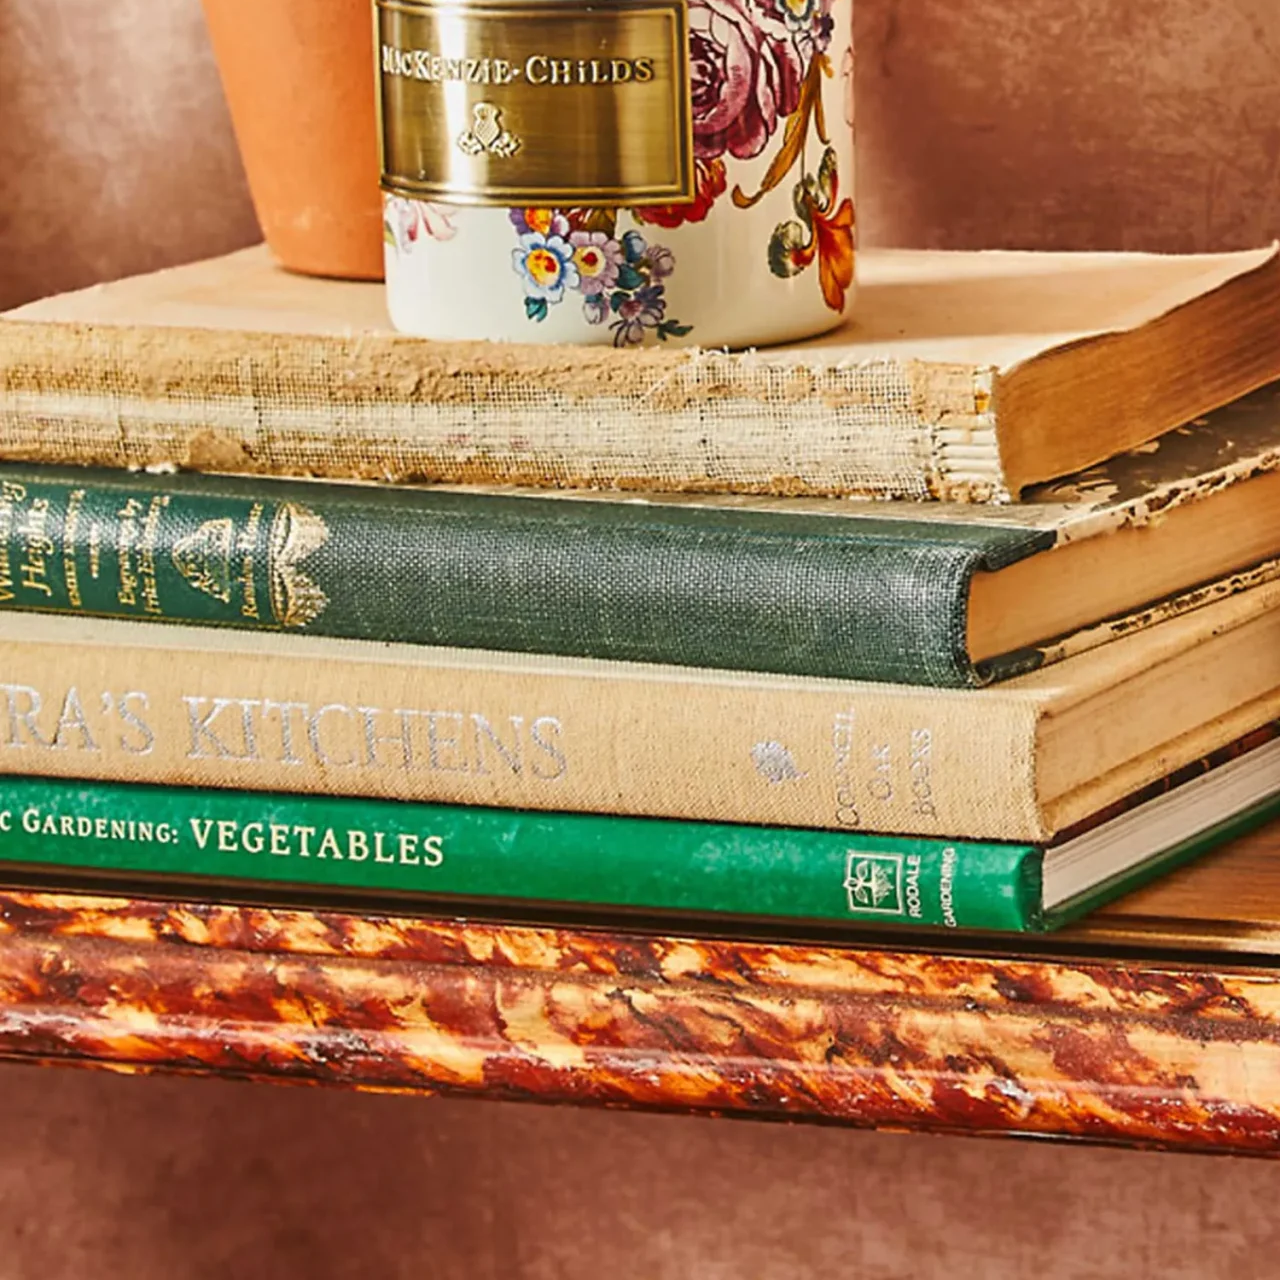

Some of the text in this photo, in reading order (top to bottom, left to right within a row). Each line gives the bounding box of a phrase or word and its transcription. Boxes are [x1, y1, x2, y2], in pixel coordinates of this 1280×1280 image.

[18, 497, 54, 597] Heights
[237, 556, 260, 620] Random
[182, 695, 568, 781] KITCHENS
[22, 808, 179, 845] GARDENING:
[189, 818, 445, 867] VEGETABLES
[906, 855, 922, 917] RODALE
[941, 847, 957, 927] GARDENING
